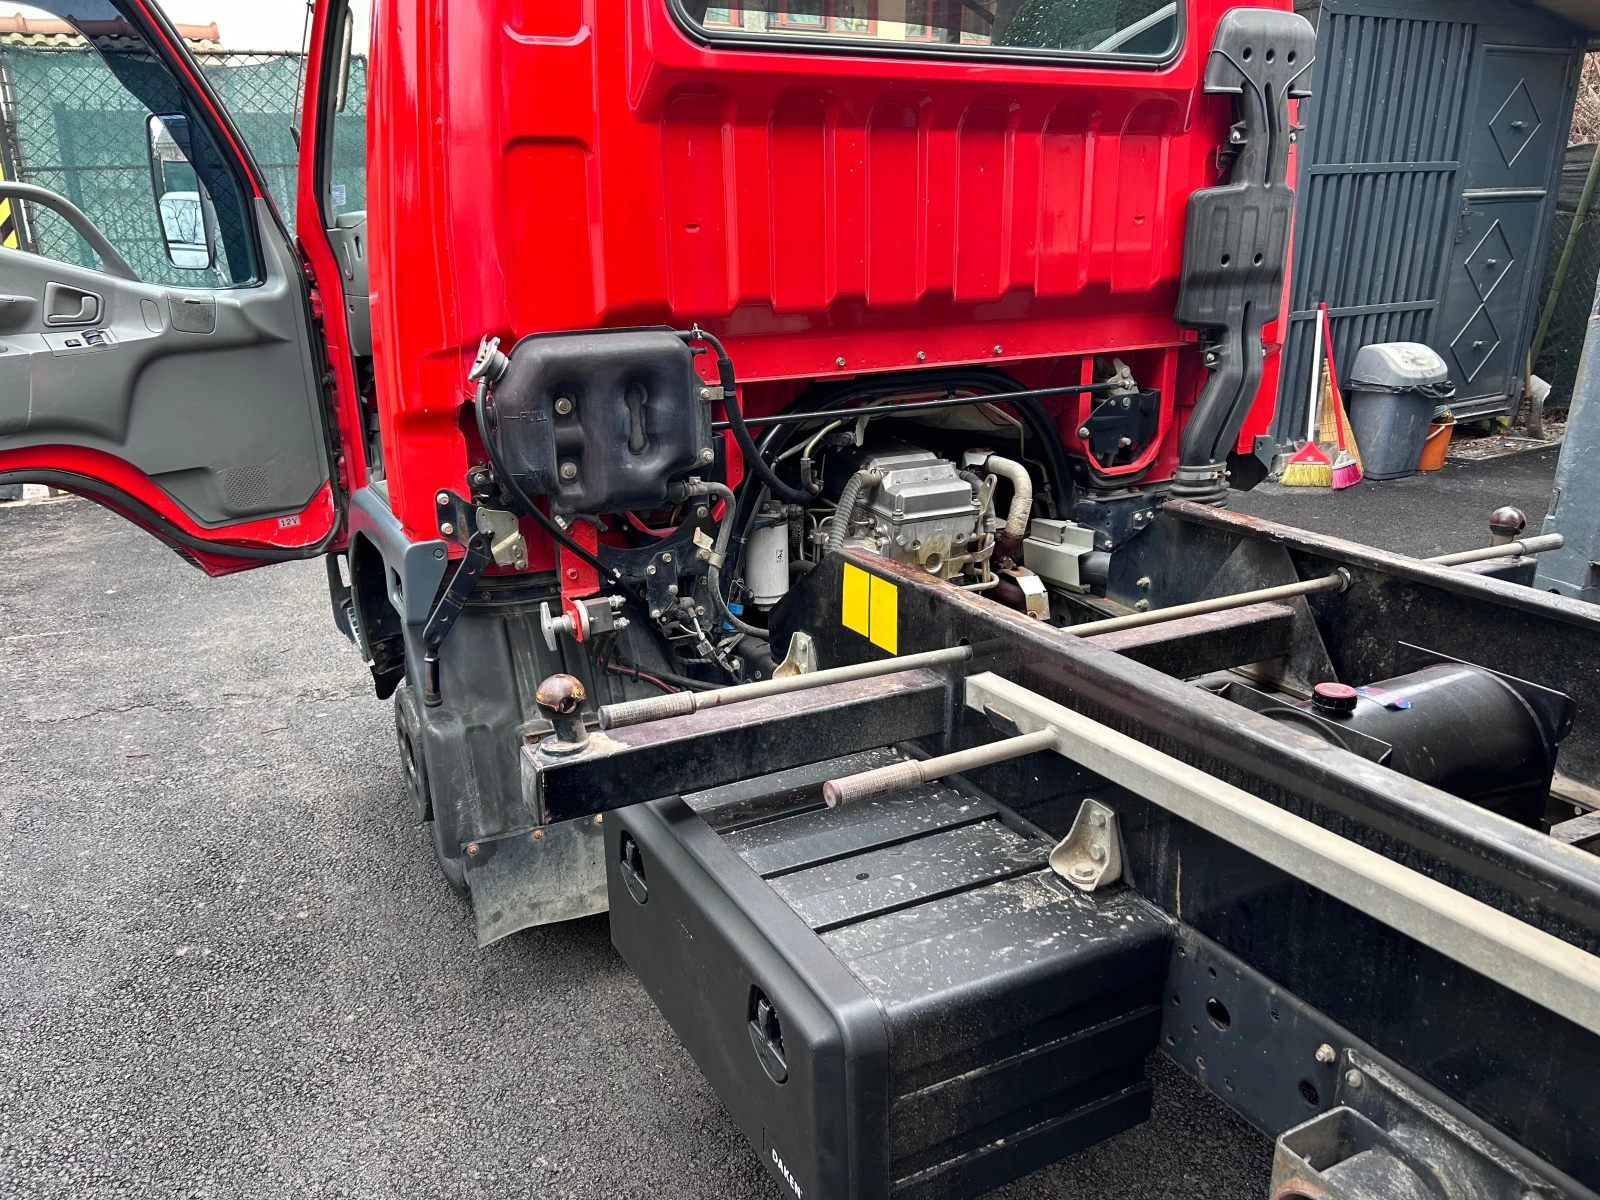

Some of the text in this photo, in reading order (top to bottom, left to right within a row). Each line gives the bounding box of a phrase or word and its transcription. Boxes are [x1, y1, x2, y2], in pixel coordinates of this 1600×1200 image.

[520, 410, 548, 423] FULL
[527, 467, 547, 479] LOW
[281, 516, 298, 527] 12V
[772, 1148, 802, 1199] DAKEN
